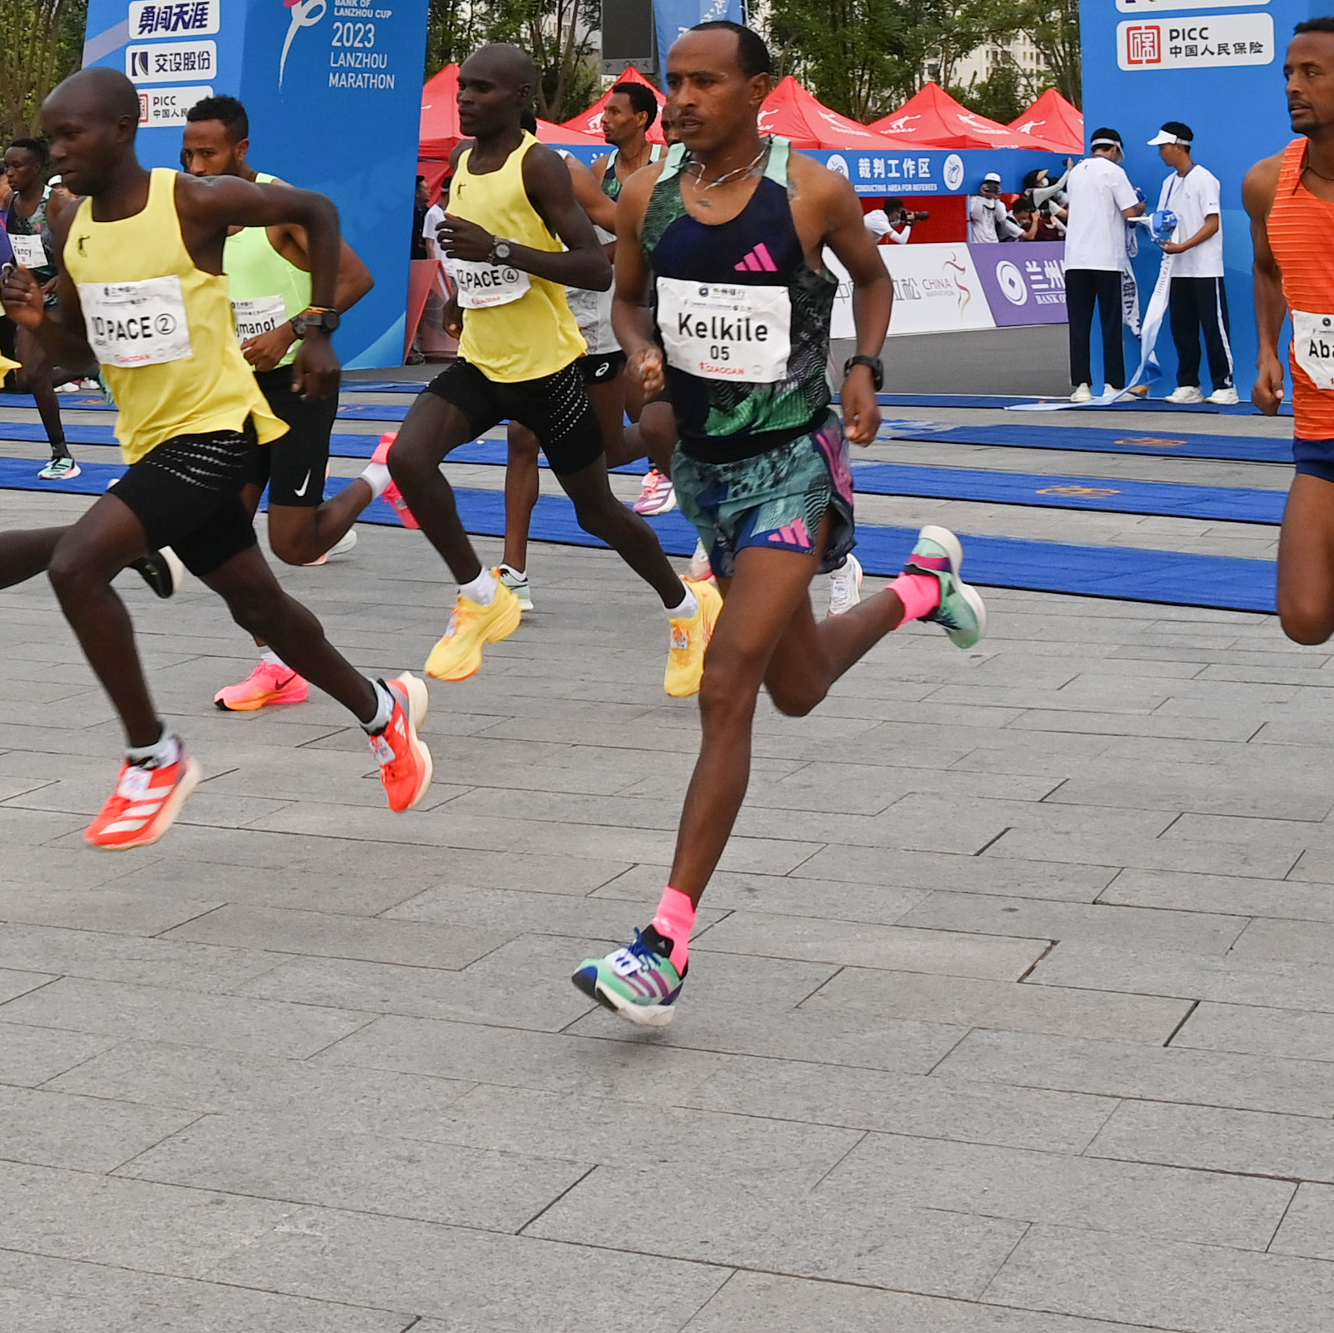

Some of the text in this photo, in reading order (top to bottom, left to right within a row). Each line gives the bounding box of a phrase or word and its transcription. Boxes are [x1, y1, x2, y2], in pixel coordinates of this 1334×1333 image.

[359, 0, 371, 8] OF
[137, 1, 210, 36] 勇闯天涯
[333, 8, 392, 19] LANZHOU CUP
[331, 22, 375, 48] 2023
[1169, 27, 1209, 42] PICC
[1169, 41, 1264, 59] 中国人民保险
[154, 50, 211, 73] 交设股份
[330, 52, 388, 70] LANZHOU
[328, 73, 395, 89] MARATHON
[153, 95, 177, 107] PICC
[858, 157, 931, 179] 裁判工作区
[1025, 259, 1066, 289] 兰州
[1035, 293, 1058, 305] BANK
[678, 312, 768, 342] Kelkile
[710, 345, 730, 361] 05
